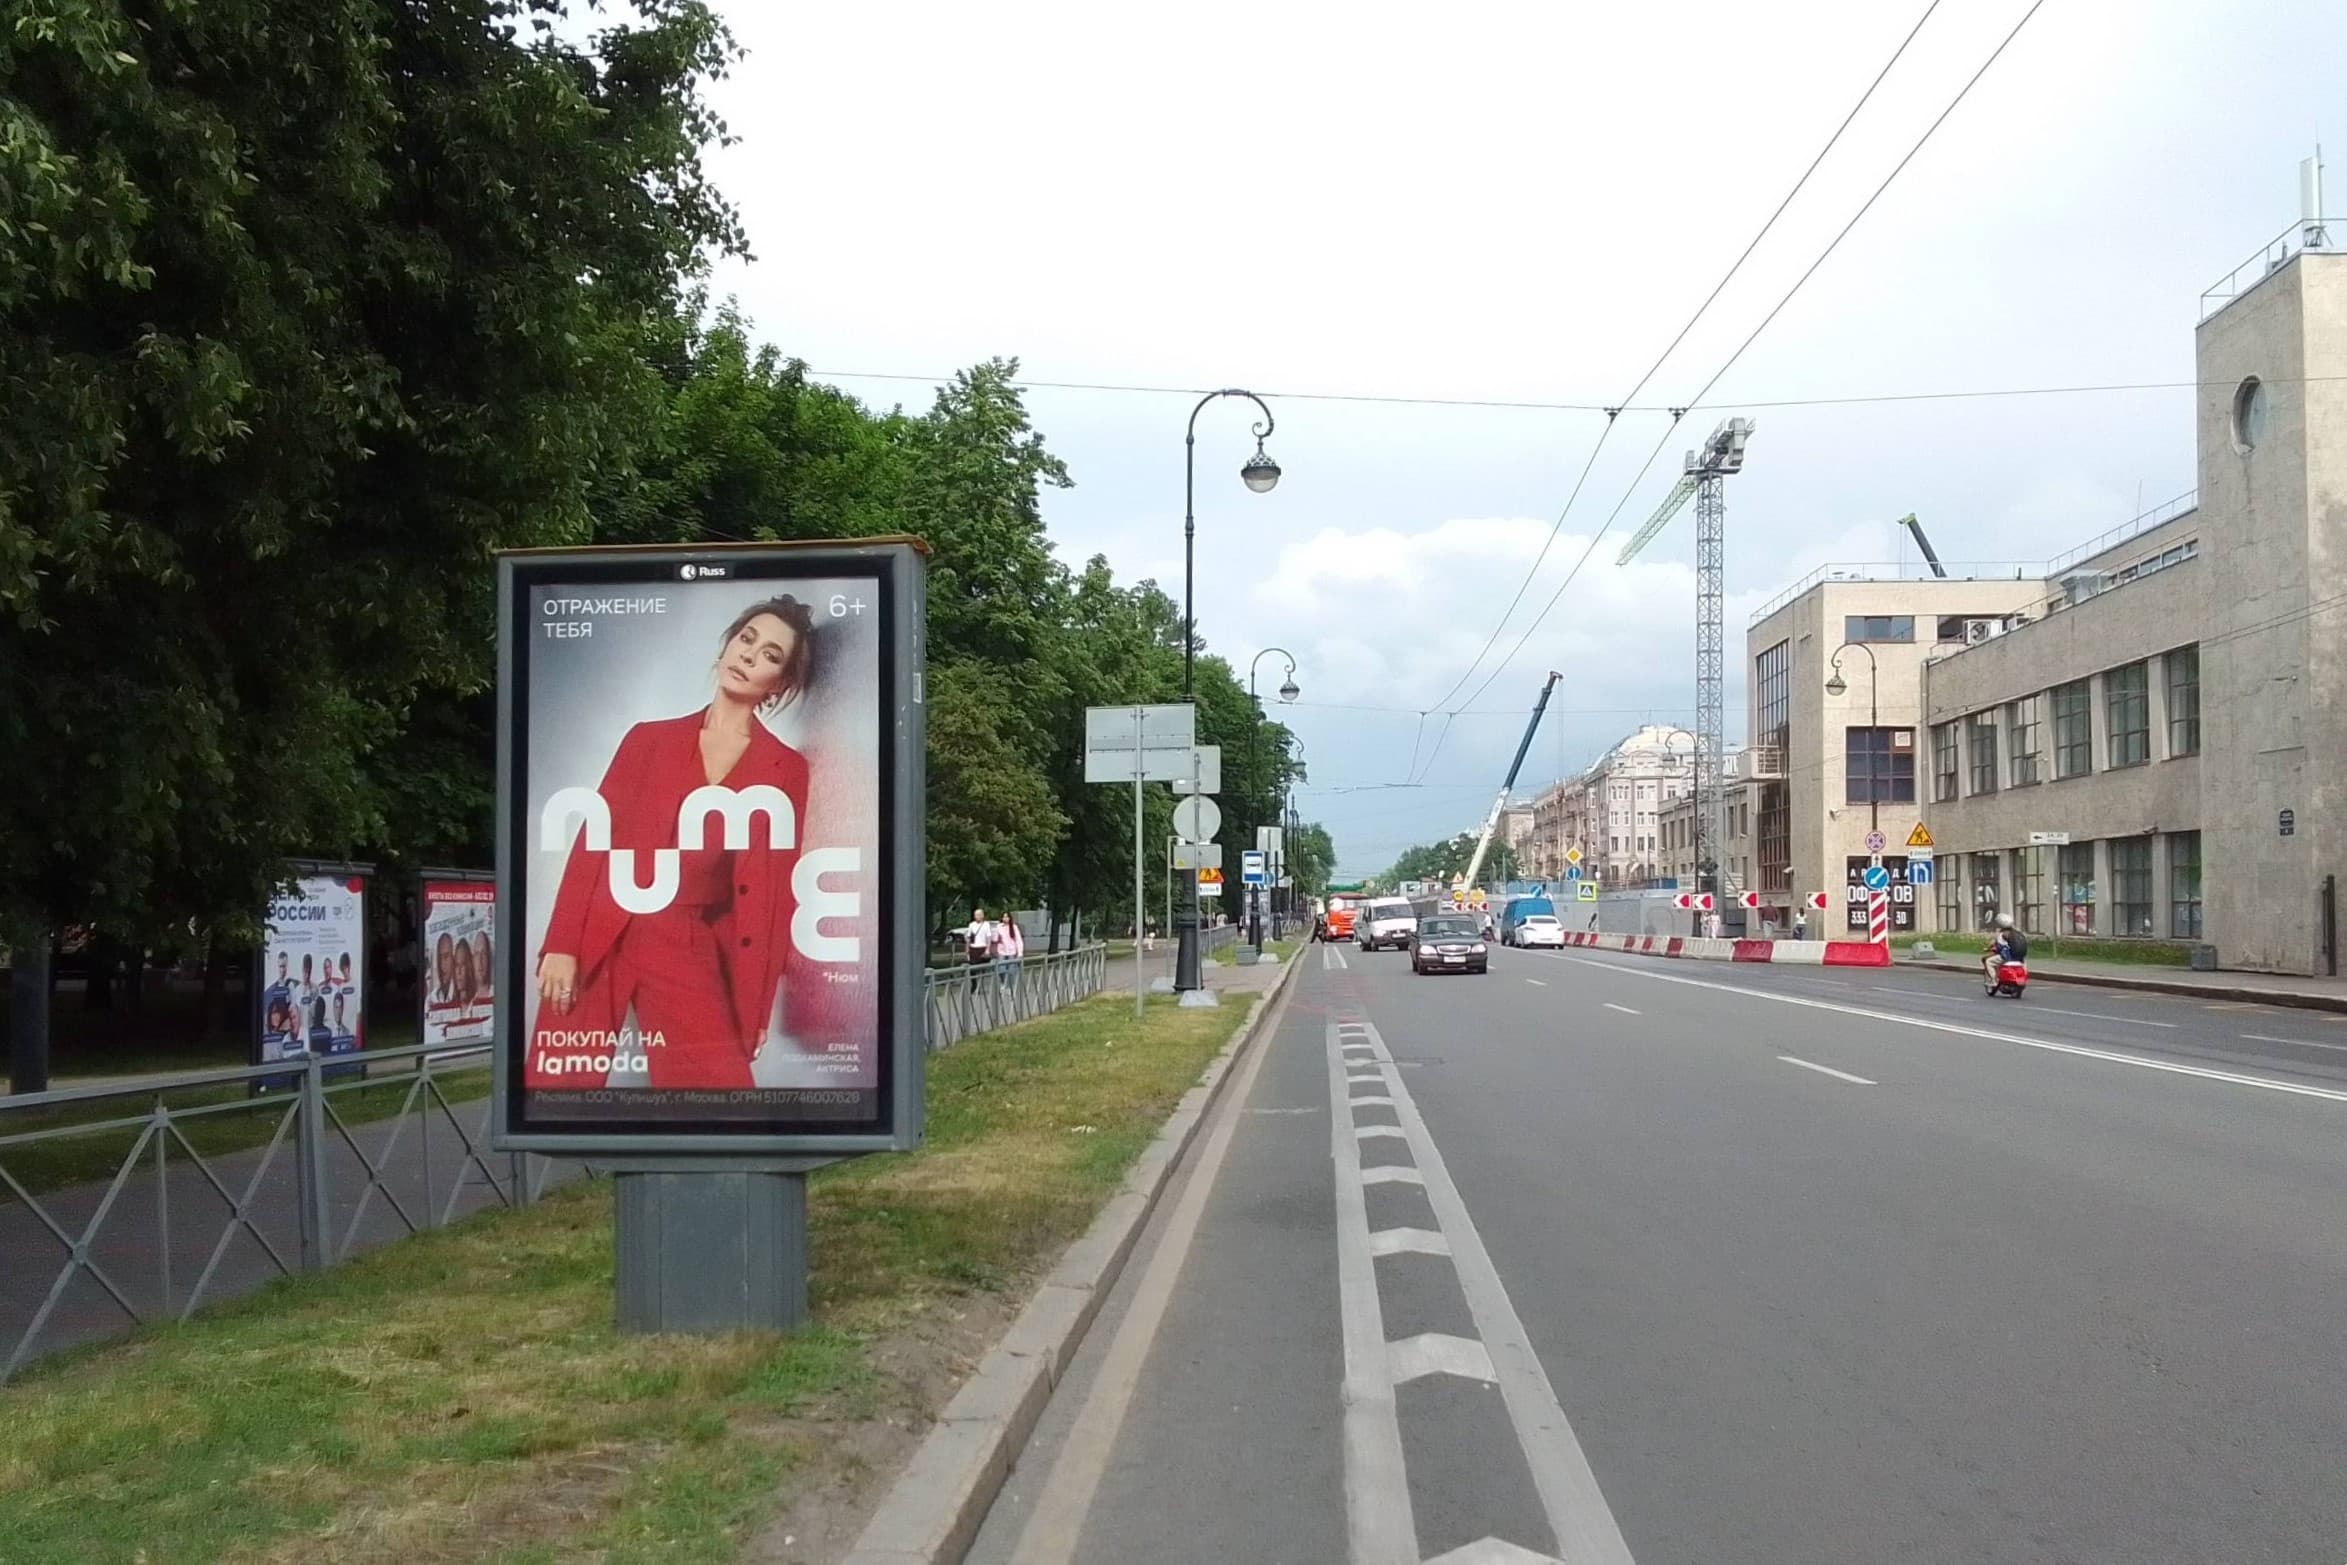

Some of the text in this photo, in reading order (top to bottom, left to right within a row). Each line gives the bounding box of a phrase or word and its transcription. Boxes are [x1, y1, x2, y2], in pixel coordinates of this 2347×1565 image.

[699, 566, 726, 576] Russ
[543, 598, 667, 615] ОТРАЖЕНИЕ
[830, 594, 867, 617] 6+
[543, 622, 592, 638] ТЕБЯ
[537, 1027, 666, 1047] ПОКУПАЙ НА
[827, 1042, 860, 1052] ЕЛЕНА
[537, 1050, 649, 1075] lamoda
[815, 1064, 860, 1073] АКТРИСА
[585, 1090, 613, 1103] ООО
